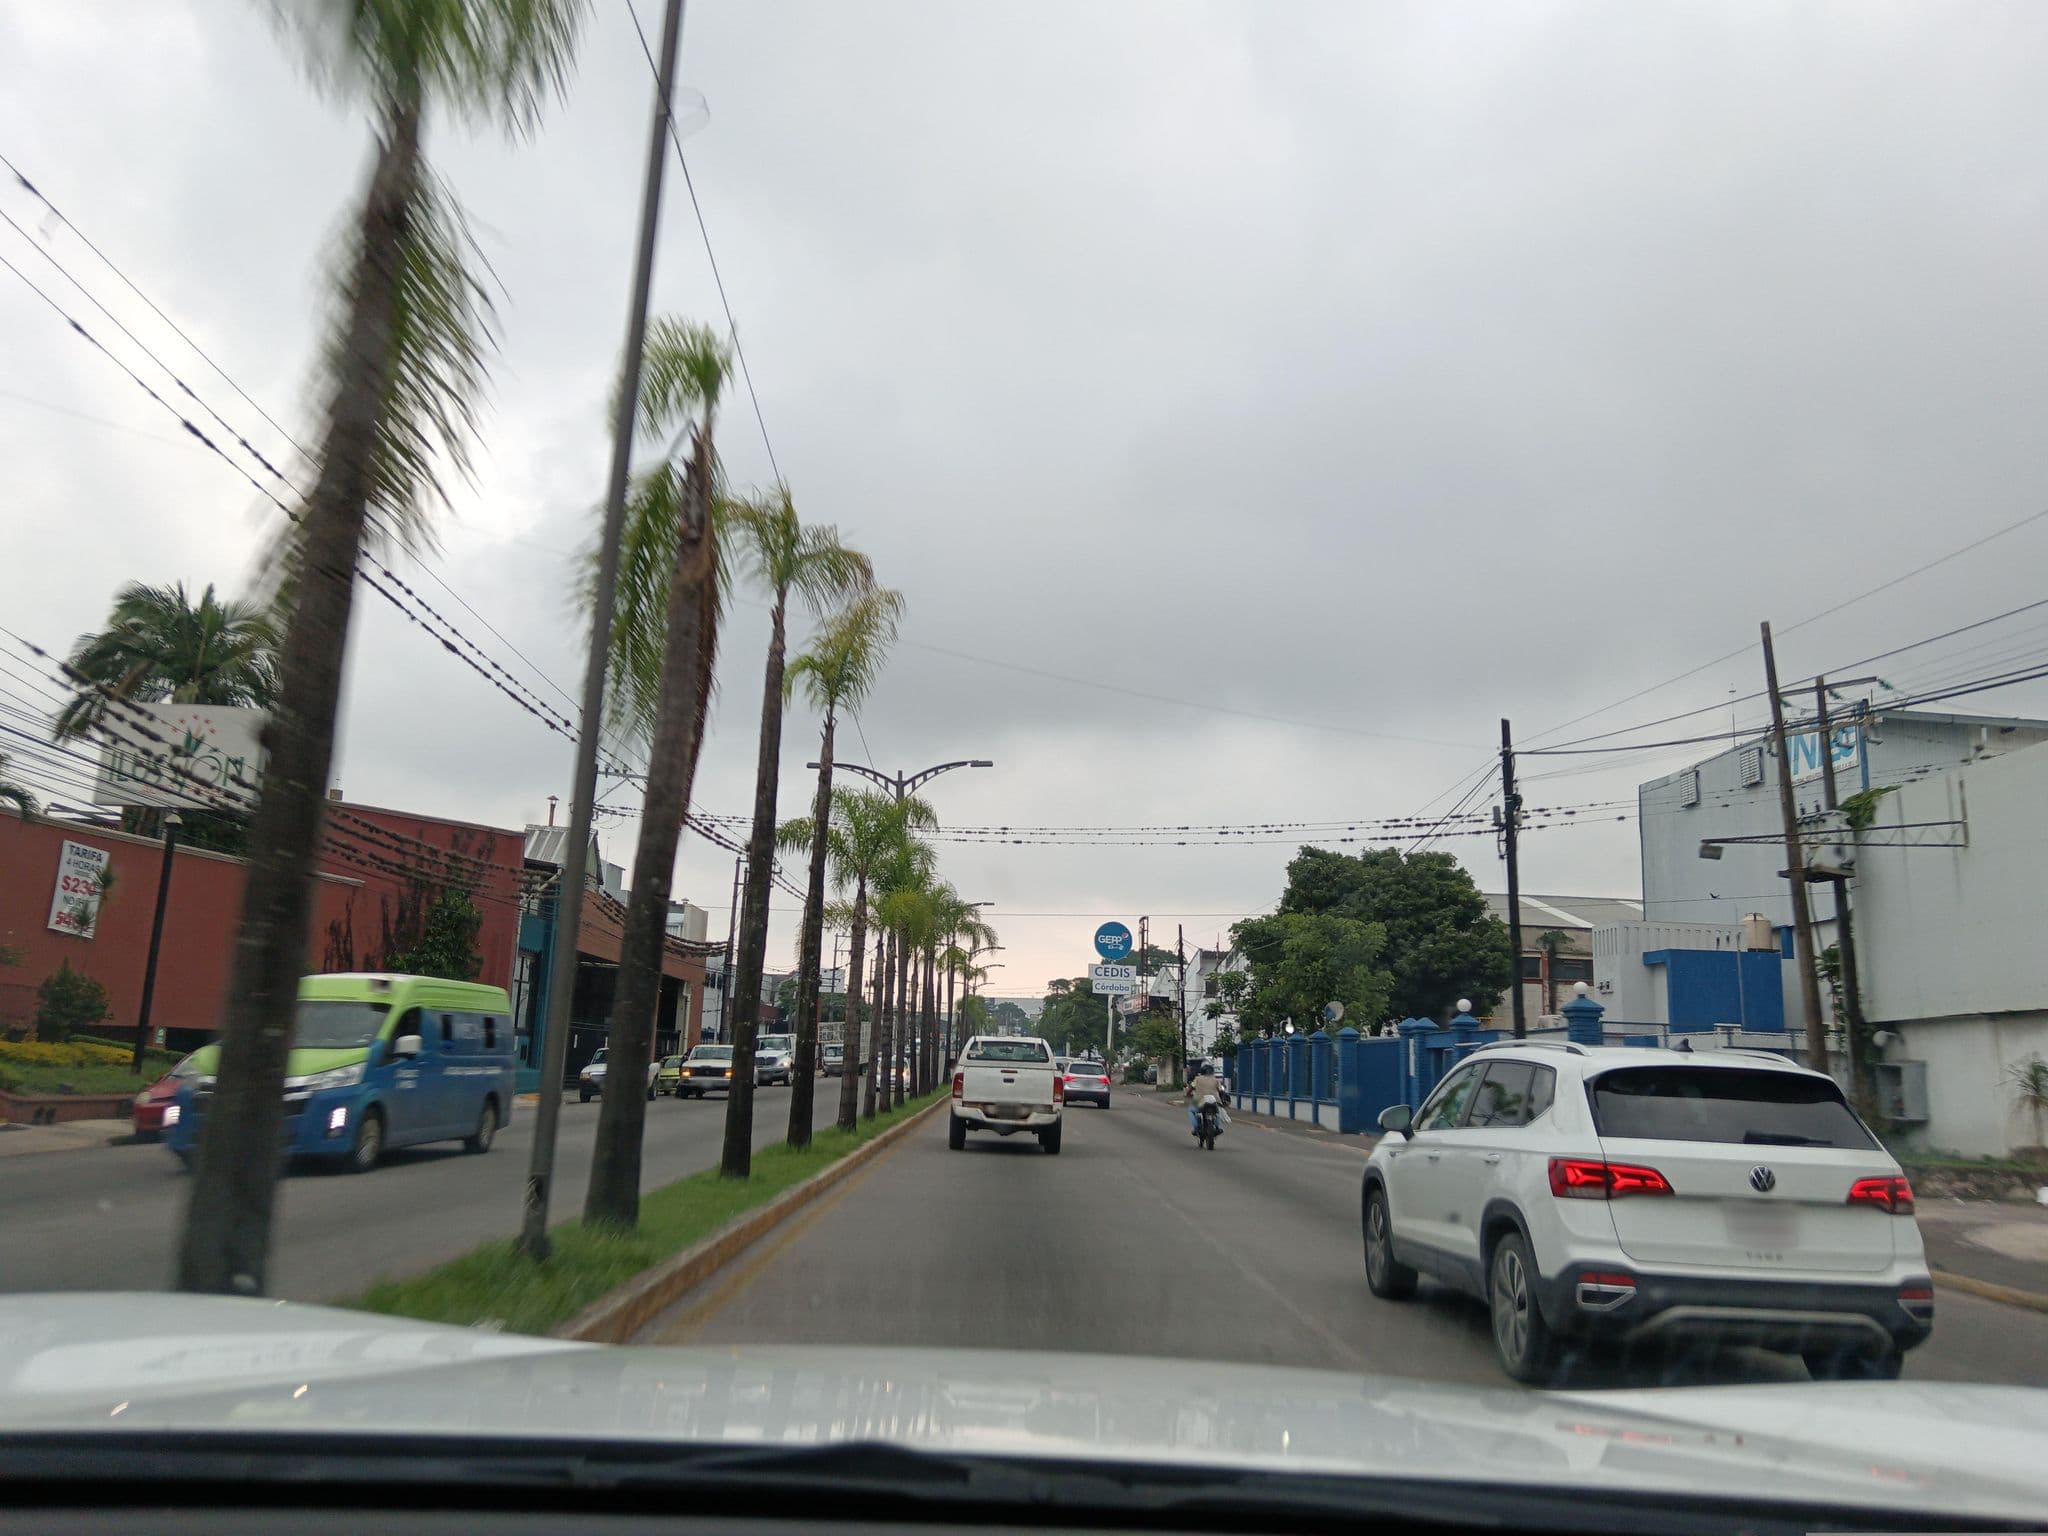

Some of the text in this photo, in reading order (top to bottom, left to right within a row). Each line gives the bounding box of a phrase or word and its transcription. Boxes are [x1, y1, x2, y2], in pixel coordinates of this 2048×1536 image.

[69, 844, 102, 863] TARIFA
[1097, 934, 1122, 944] GEPP
[1094, 966, 1130, 978] CEDIS
[1094, 982, 1130, 992] Córdoba
